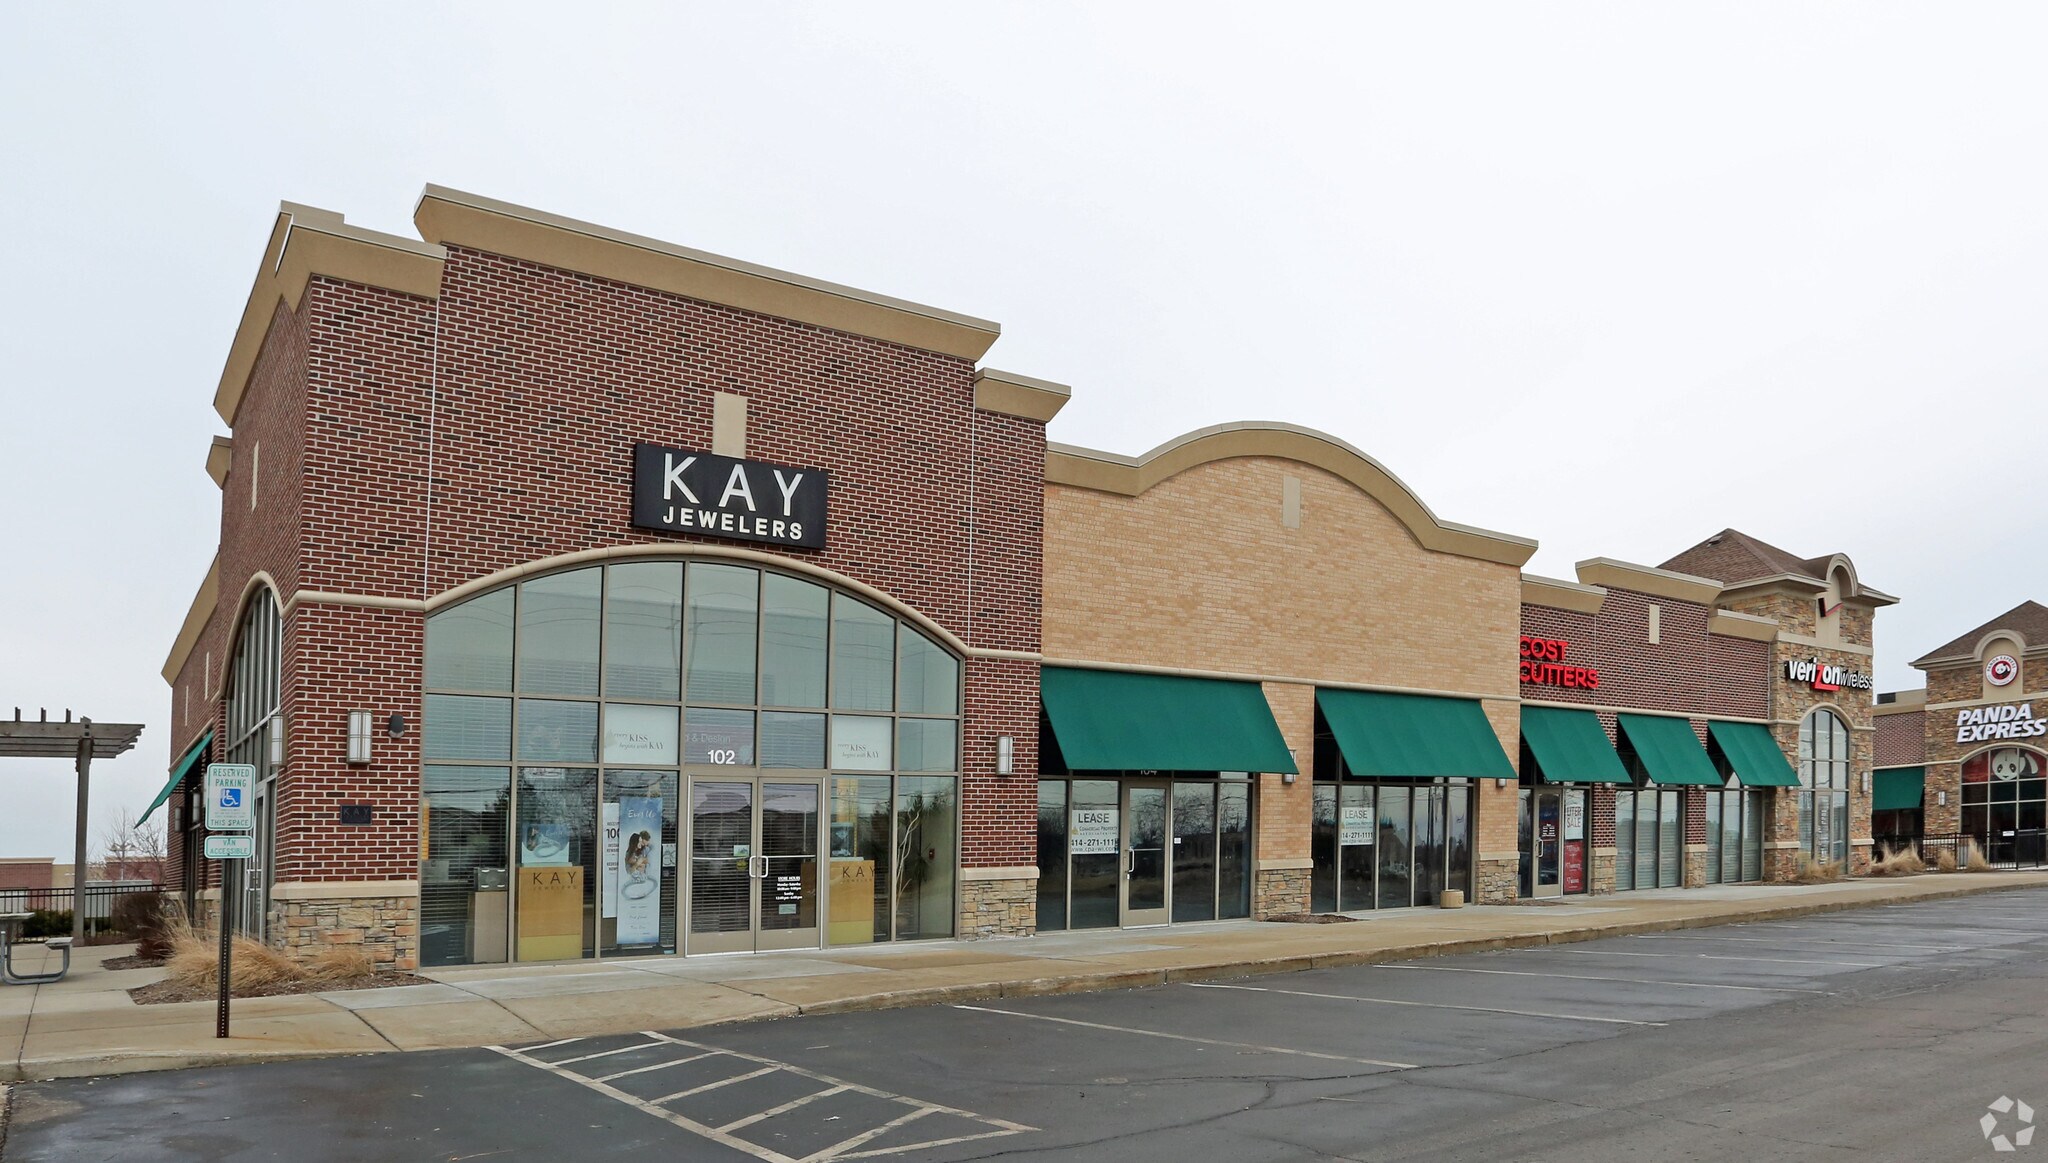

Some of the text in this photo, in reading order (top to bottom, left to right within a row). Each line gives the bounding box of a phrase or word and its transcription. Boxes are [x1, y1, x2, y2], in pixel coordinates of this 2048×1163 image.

[663, 452, 804, 517] KAY
[662, 506, 803, 540] JEWELERS
[1520, 636, 1569, 661] COST
[1520, 661, 1599, 689] CUTTERS
[1788, 656, 1873, 691] verizon wireless
[1956, 703, 2032, 727] PANDA
[1956, 718, 2047, 743] EXPRESS
[629, 733, 649, 742] KISS
[649, 741, 664, 749] KAY
[707, 749, 736, 765] 102
[213, 768, 250, 777] RESERVED
[215, 779, 247, 787] PARKING
[343, 807, 370, 816] KAY
[1344, 811, 1368, 819] LEASE
[228, 819, 249, 827] SPACE
[1078, 813, 1110, 823] LEASE
[1566, 817, 1582, 828] SALE
[532, 871, 577, 885] KAY
[842, 866, 875, 878] KAY
